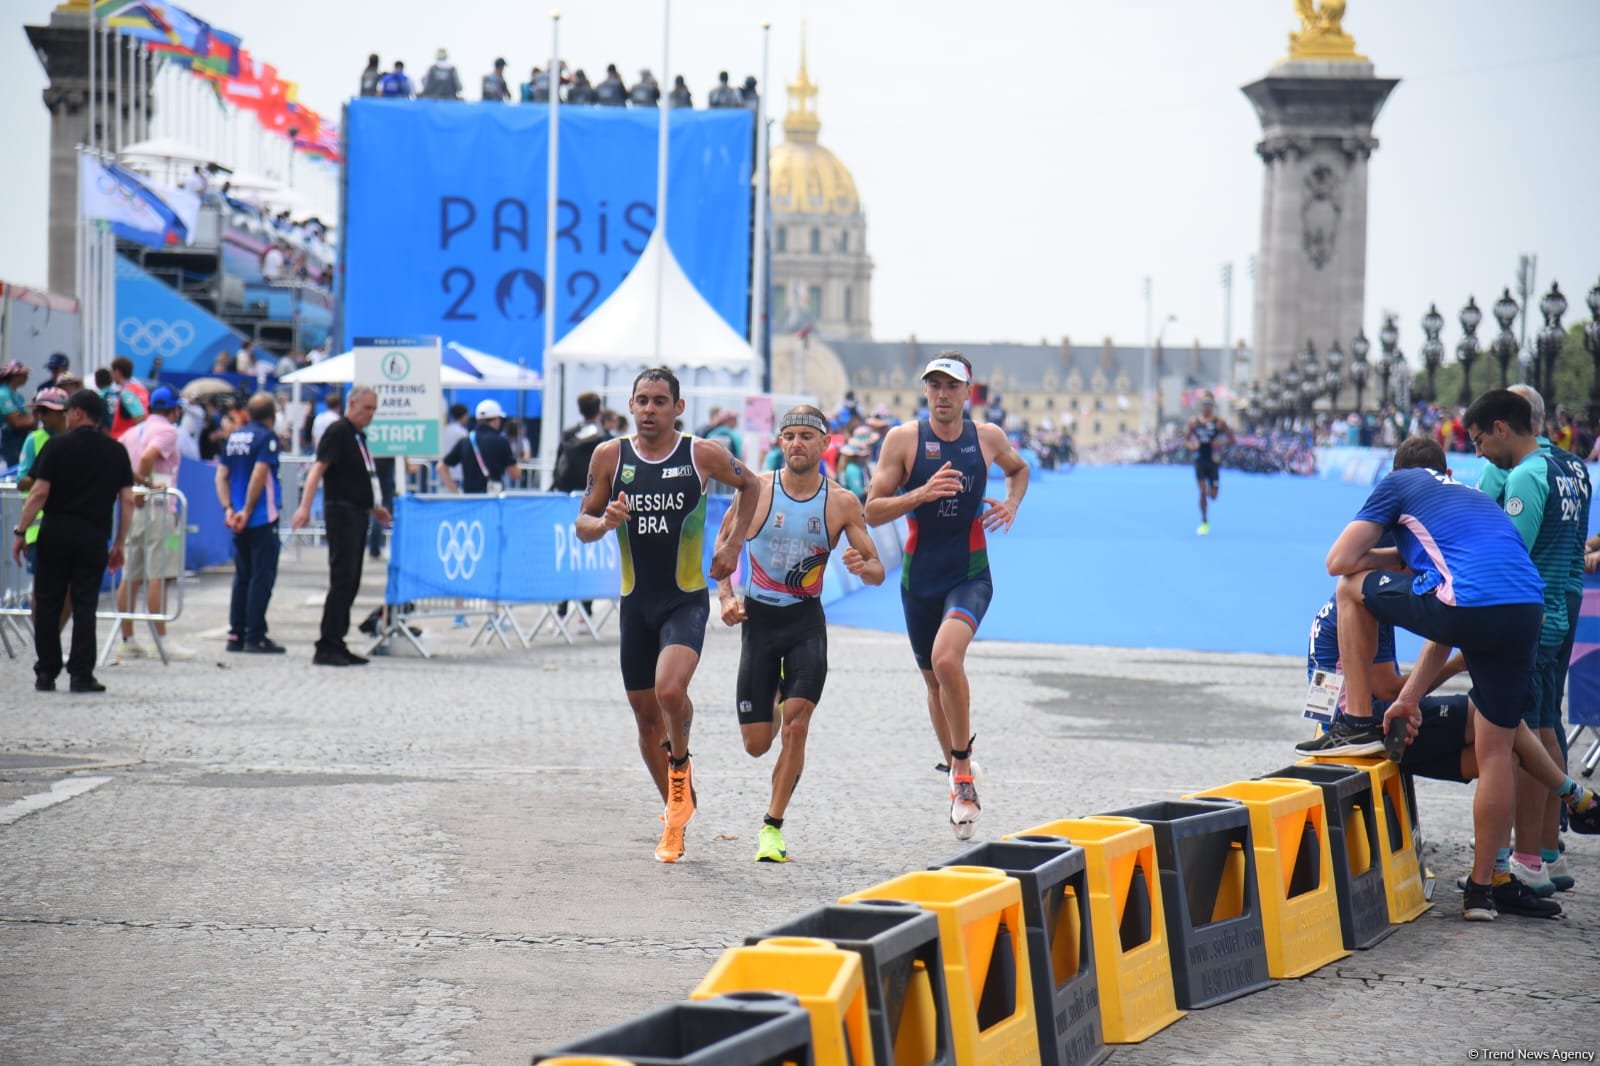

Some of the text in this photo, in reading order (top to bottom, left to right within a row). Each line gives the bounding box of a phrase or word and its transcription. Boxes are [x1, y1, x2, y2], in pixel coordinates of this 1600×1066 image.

[440, 265, 602, 323] 202
[367, 423, 426, 443] START
[625, 492, 685, 512] MESSIAS
[937, 499, 959, 517] AZE
[638, 515, 669, 535] BRA
[769, 536, 817, 554] GEENS
[770, 552, 808, 572] BEL
